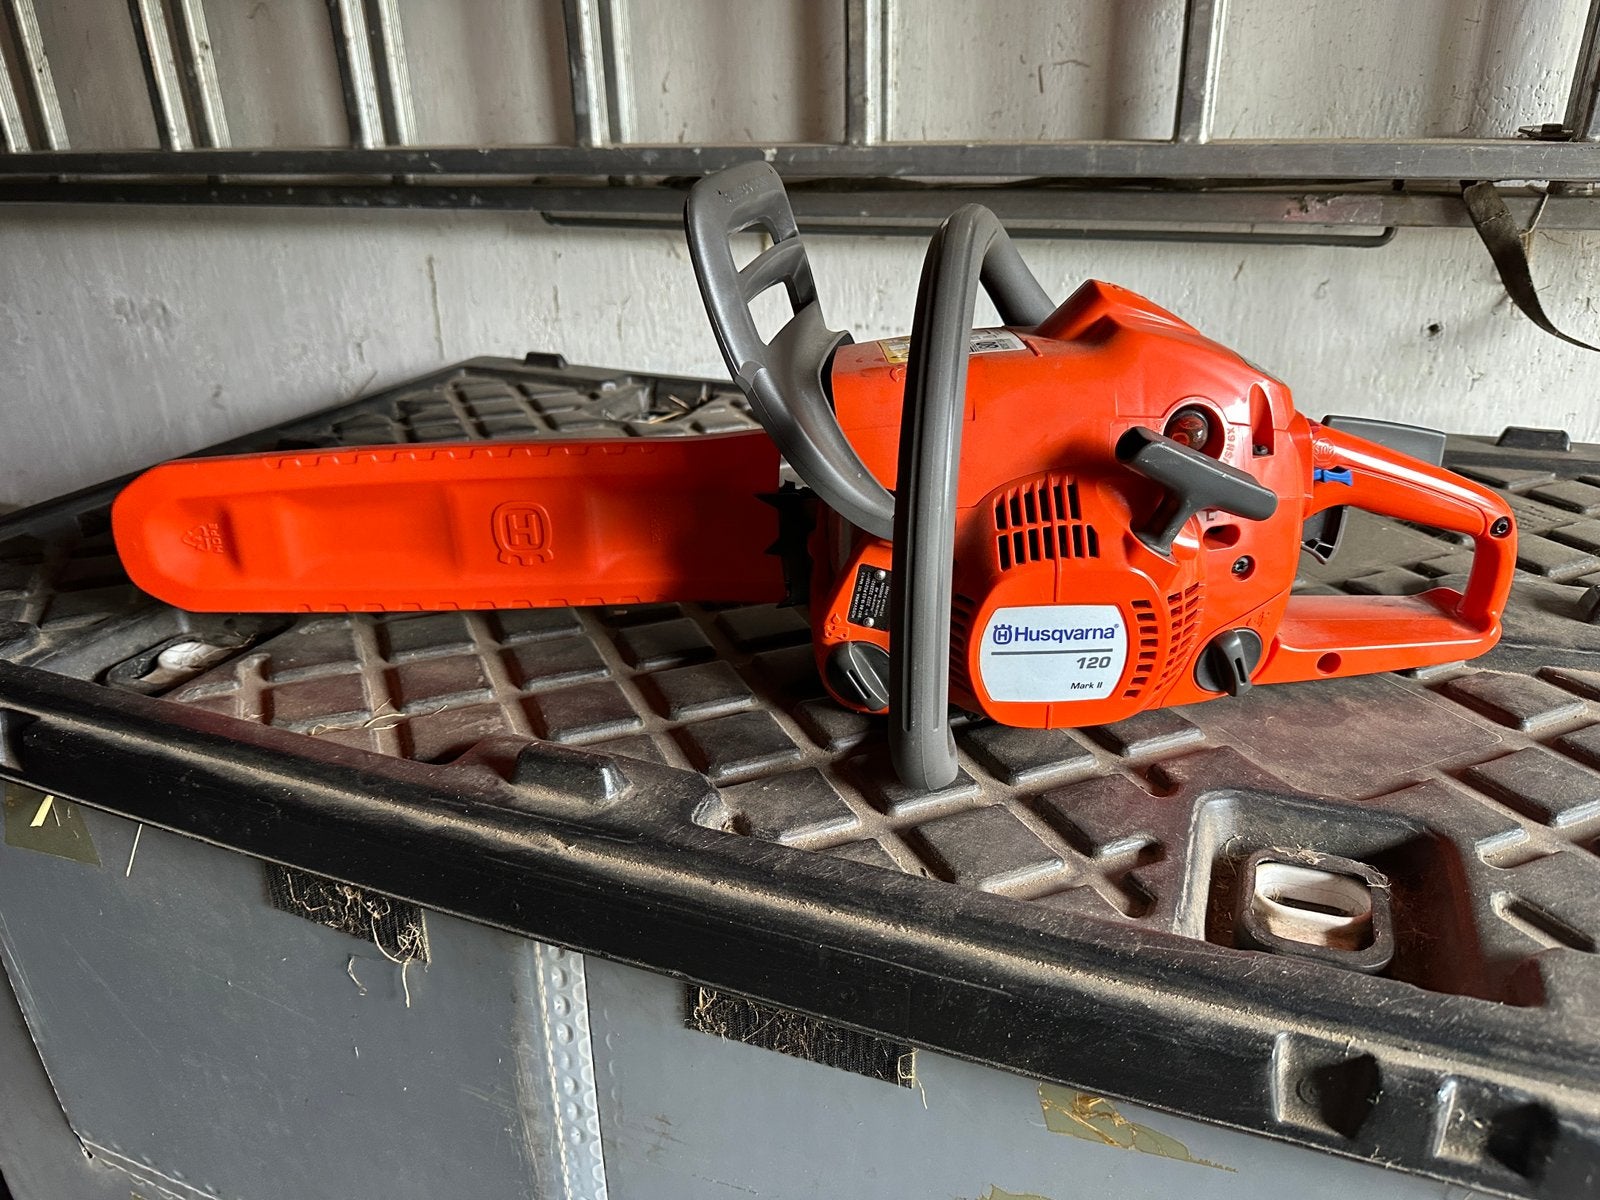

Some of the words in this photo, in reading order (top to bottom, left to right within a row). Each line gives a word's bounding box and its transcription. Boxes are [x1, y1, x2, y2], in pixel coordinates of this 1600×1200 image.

[1014, 625, 1115, 643] Husqvarna
[1076, 656, 1111, 669] 120
[1070, 682, 1094, 690] Mark
[1096, 681, 1103, 689] II
